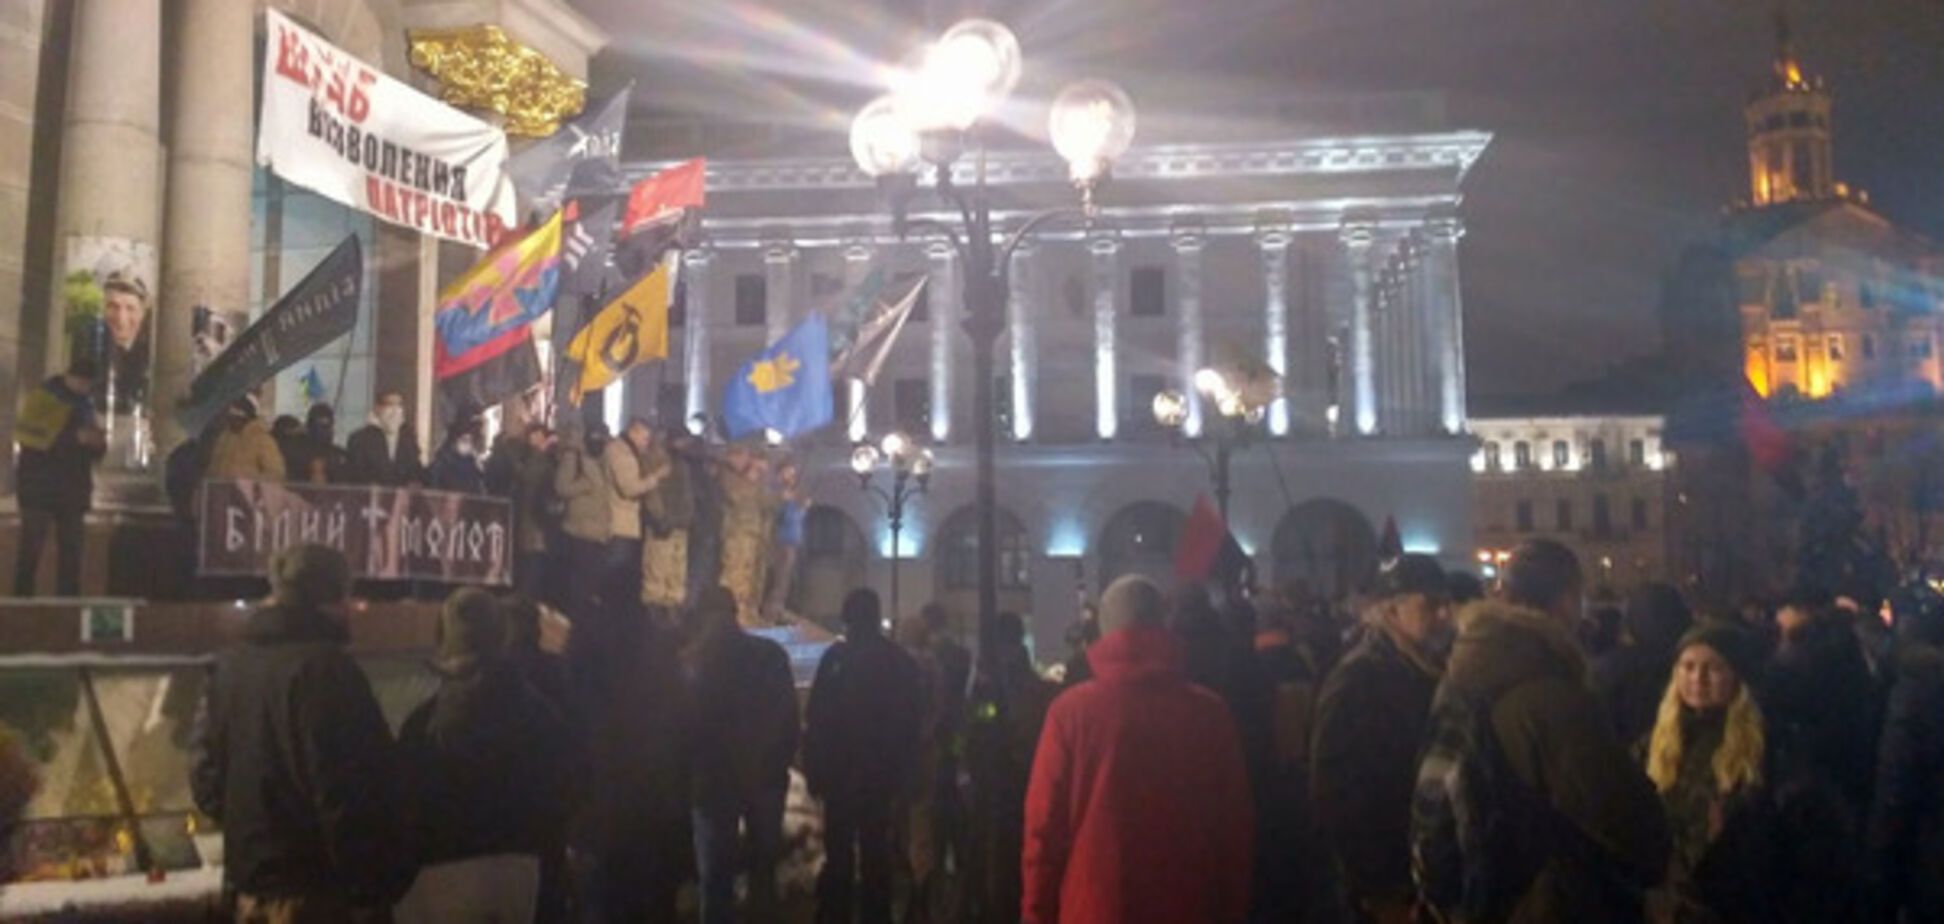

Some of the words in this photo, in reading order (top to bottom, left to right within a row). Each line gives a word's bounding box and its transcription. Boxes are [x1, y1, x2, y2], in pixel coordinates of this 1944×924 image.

[277, 24, 377, 124] ШАБ
[226, 502, 346, 551] БІЛИЙ
[400, 514, 504, 561] МОЛОТ
